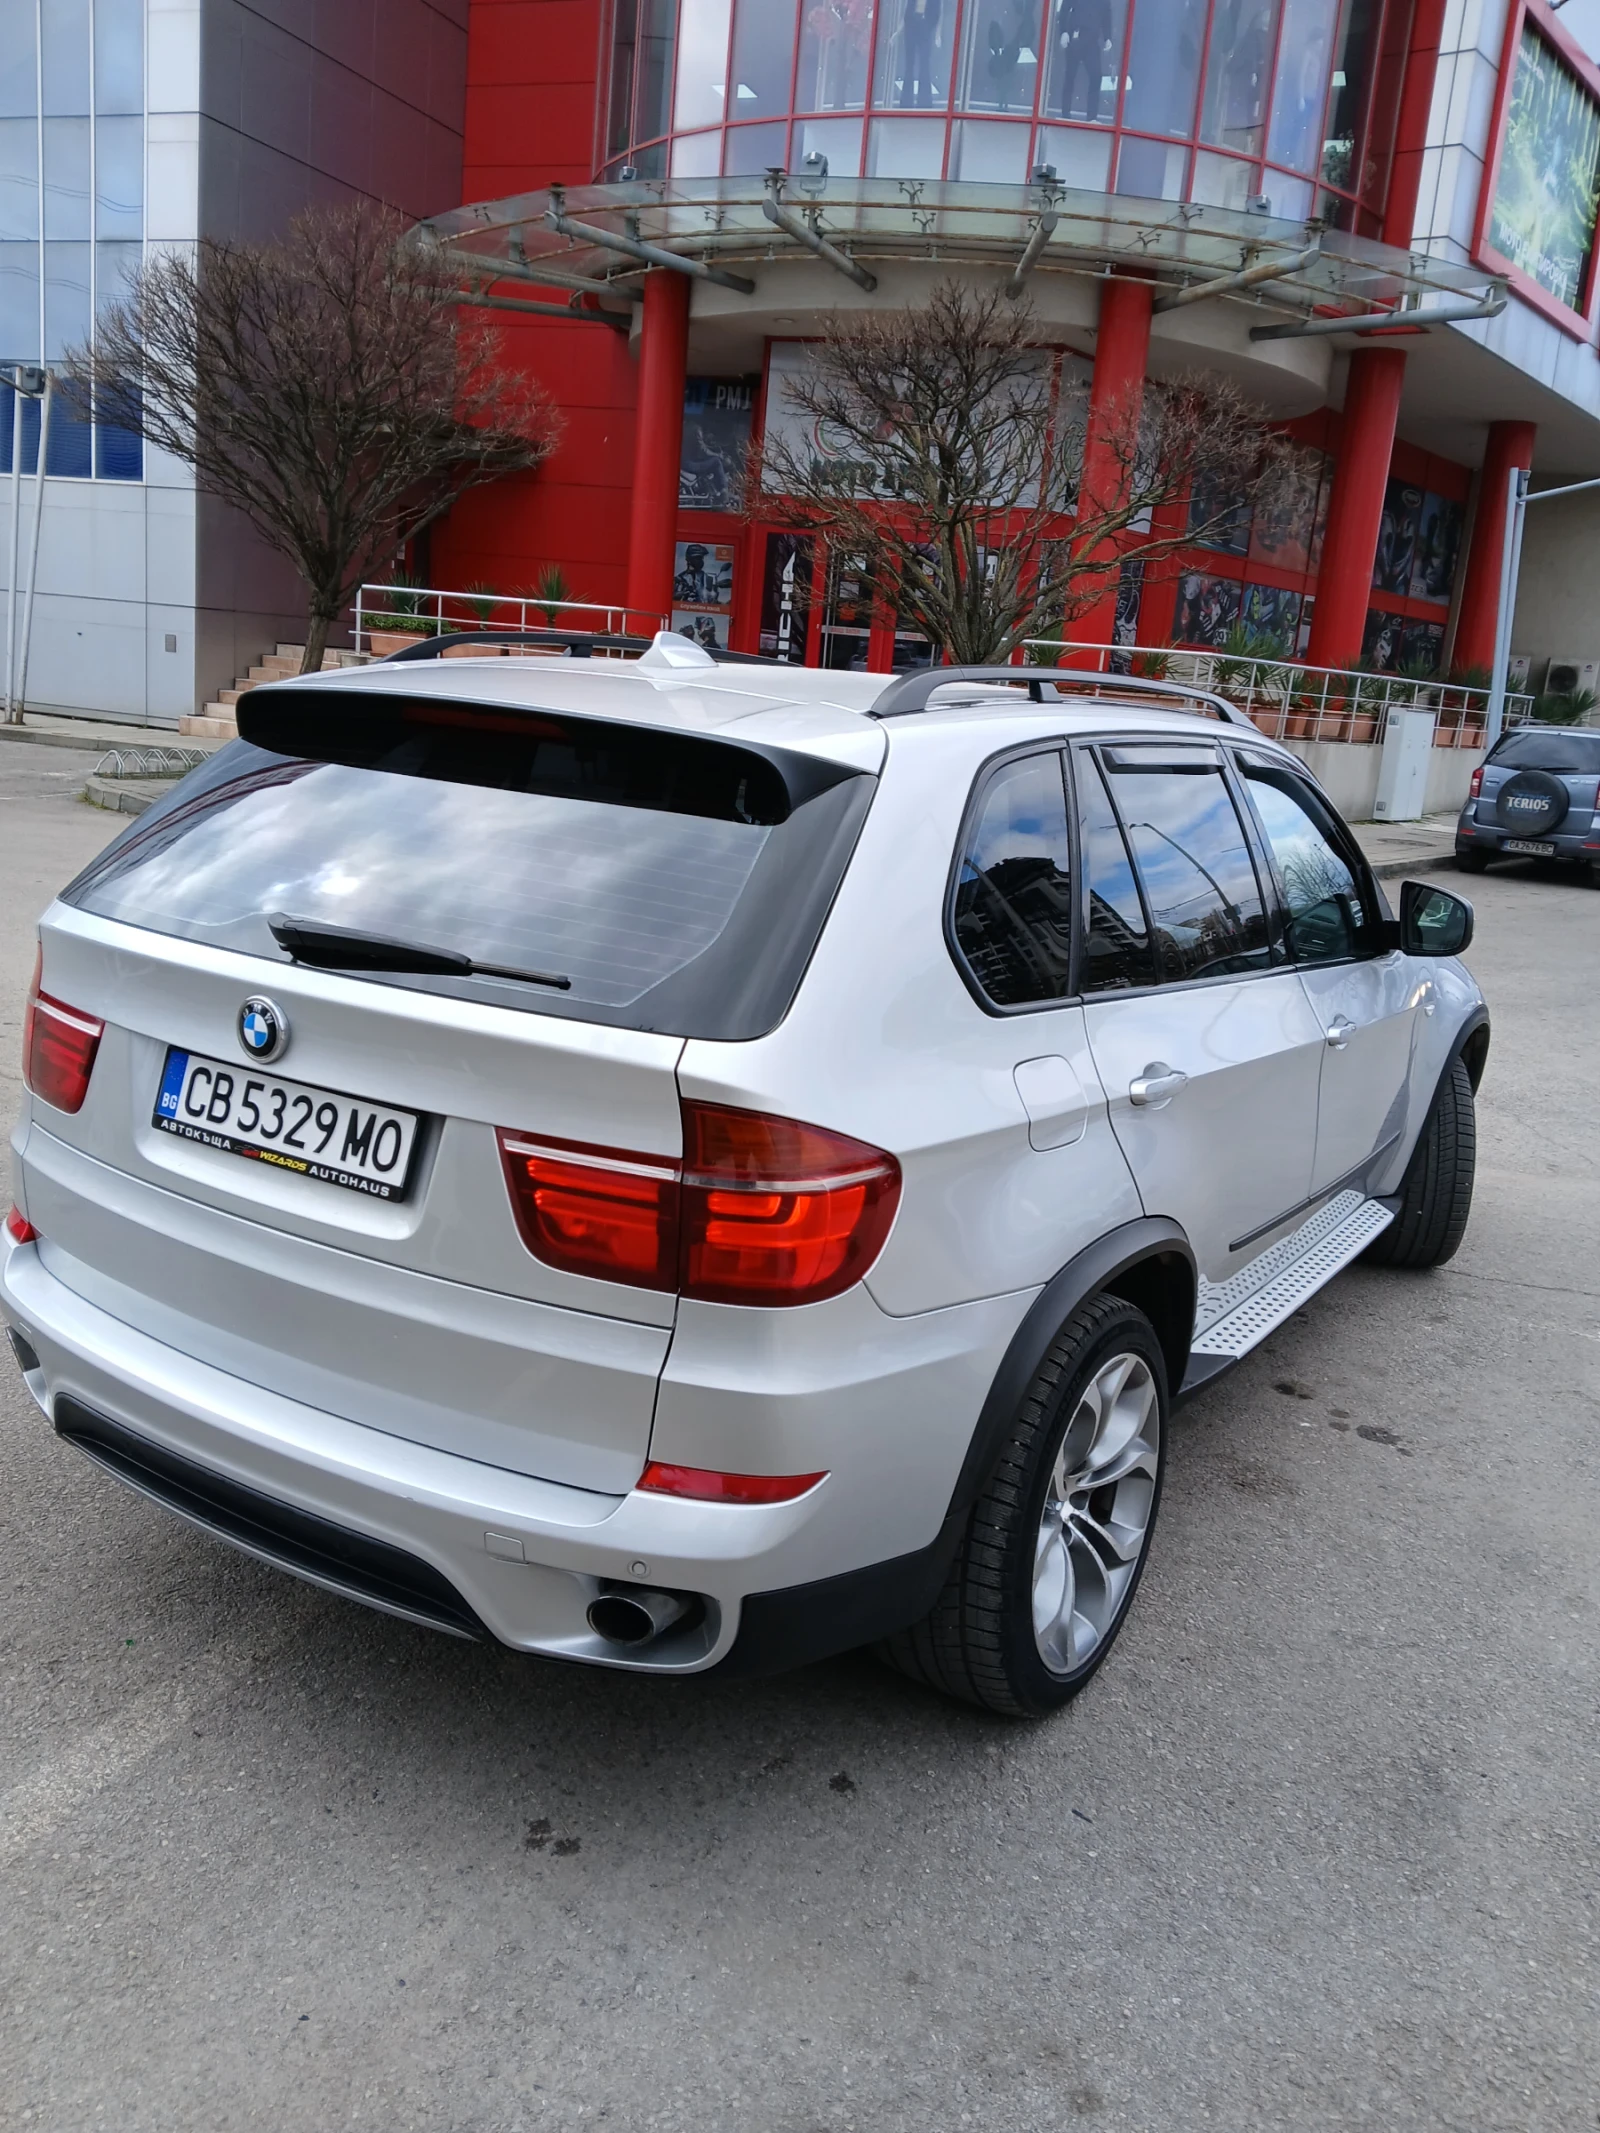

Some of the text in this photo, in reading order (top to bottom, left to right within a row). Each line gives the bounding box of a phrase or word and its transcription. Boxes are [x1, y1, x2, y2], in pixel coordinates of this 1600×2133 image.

[1506, 796, 1549, 811] TERIOS
[161, 1092, 178, 1110] BG
[161, 1119, 232, 1150] АВТОКЪЩА
[259, 1150, 390, 1197] WIZARDS AUTOHAUS
